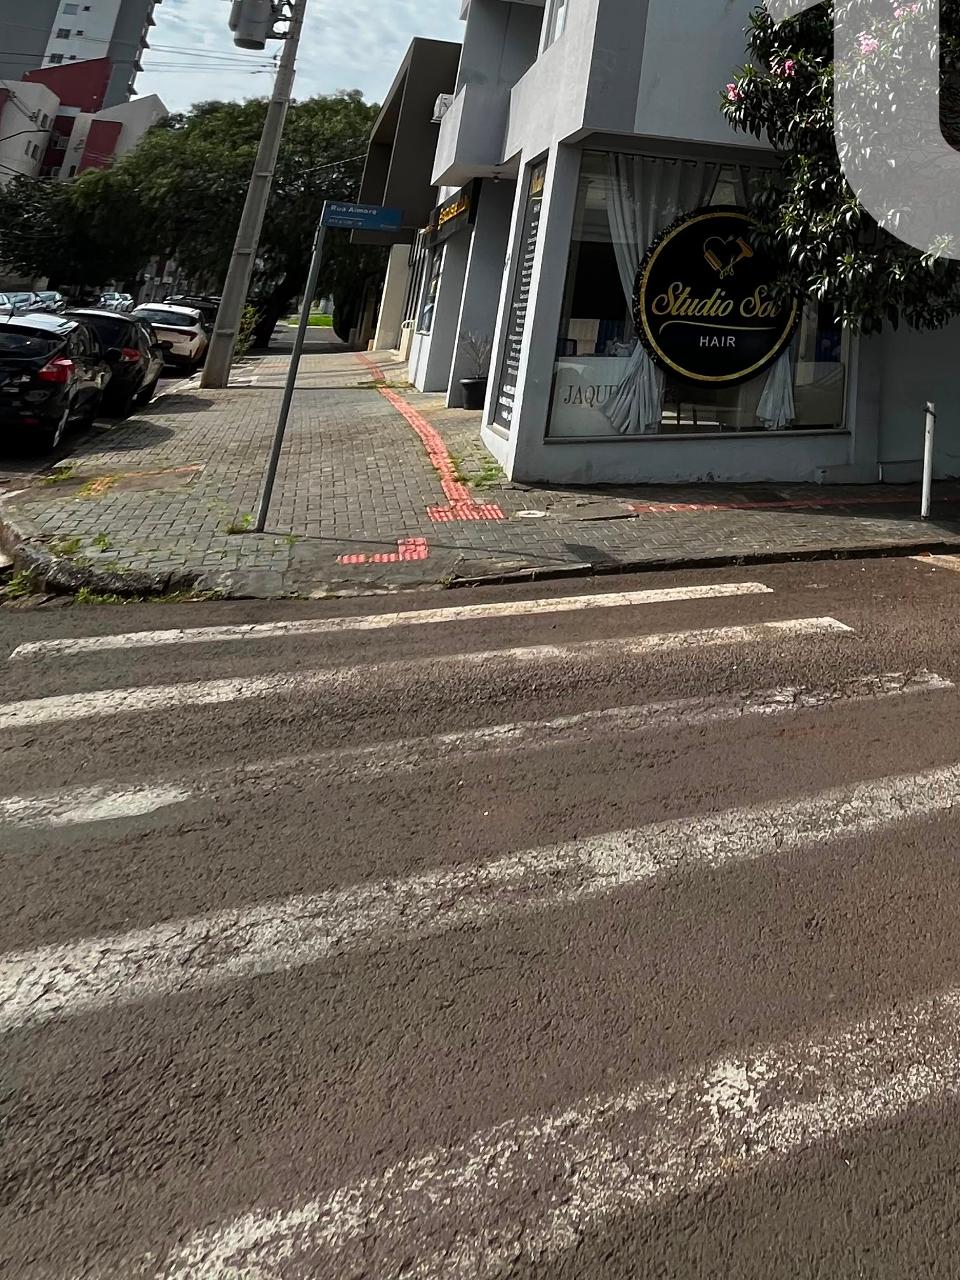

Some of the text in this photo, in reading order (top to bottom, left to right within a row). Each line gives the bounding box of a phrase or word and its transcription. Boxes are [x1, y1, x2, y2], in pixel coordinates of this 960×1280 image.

[330, 204, 346, 213] Rua
[651, 281, 734, 317] Studio
[699, 335, 736, 348] HAIR
